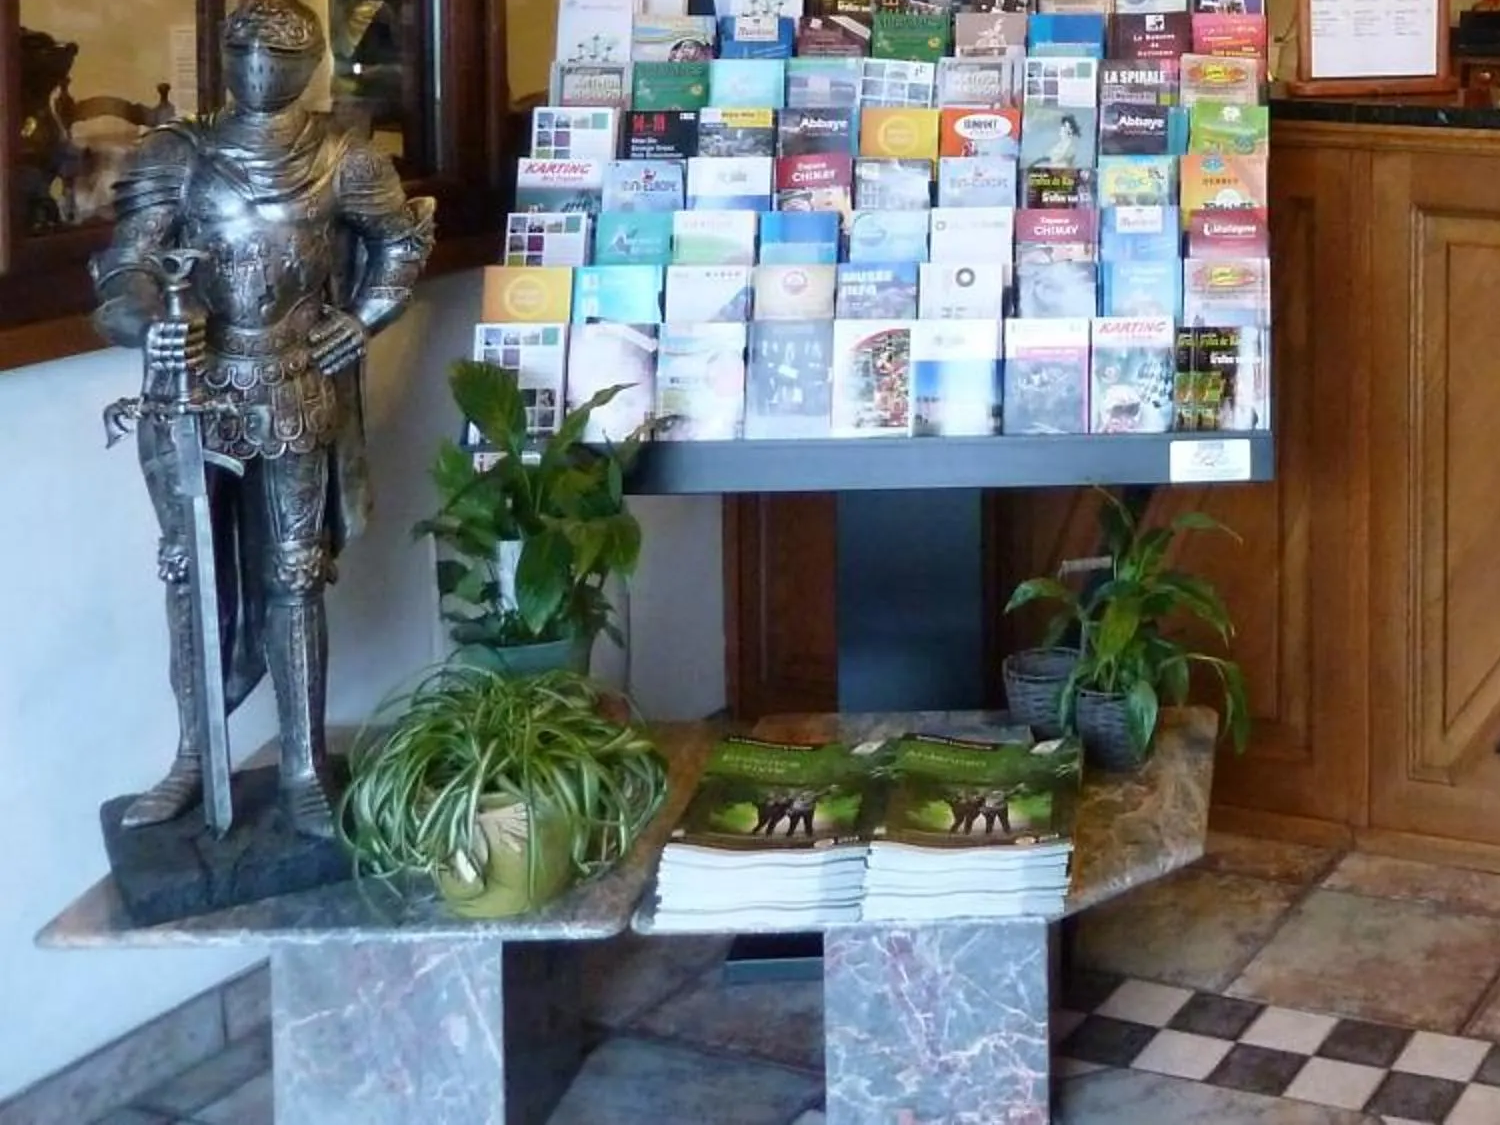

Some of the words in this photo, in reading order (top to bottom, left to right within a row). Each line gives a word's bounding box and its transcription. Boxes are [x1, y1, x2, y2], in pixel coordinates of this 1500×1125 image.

[1103, 70, 1117, 84] LA
[1119, 70, 1165, 84] SPIRALE
[800, 118, 848, 132] Abbaye
[1118, 115, 1164, 130] Abbaye
[524, 162, 592, 175] KARTING
[1033, 224, 1079, 236] CHIMAY
[1099, 320, 1167, 334] KARTING
